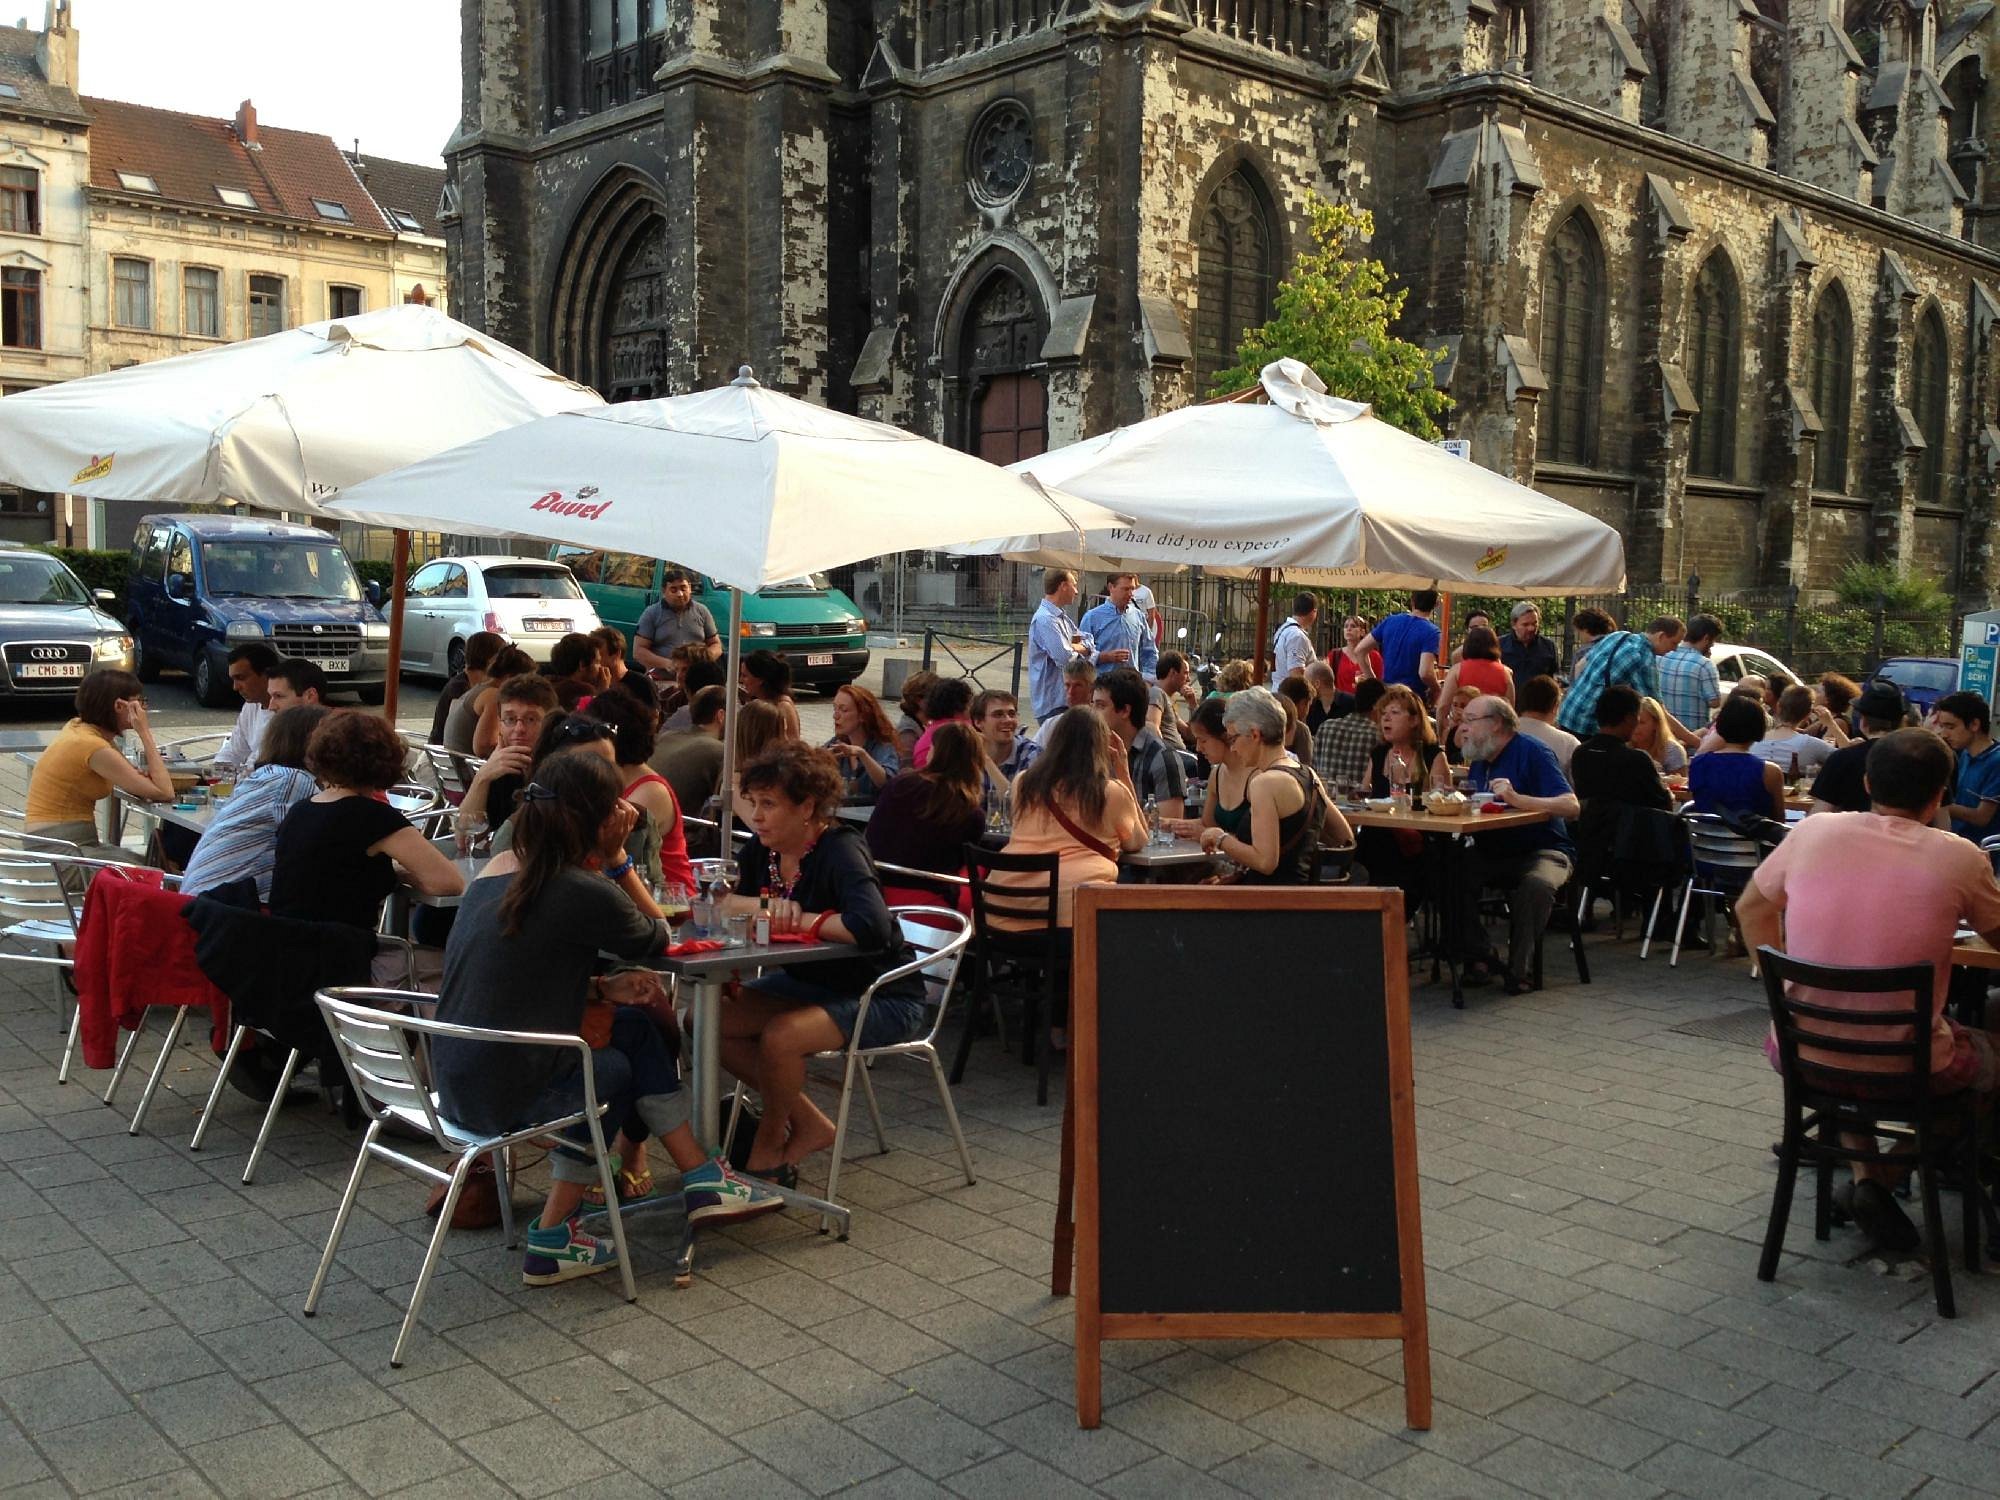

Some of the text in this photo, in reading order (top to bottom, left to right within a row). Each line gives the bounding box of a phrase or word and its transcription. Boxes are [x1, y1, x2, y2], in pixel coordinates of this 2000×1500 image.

[1444, 441, 1462, 449] ZONE
[529, 491, 613, 520] Duvel
[1110, 528, 1290, 553] What did you expect?
[1986, 623, 1999, 641] P
